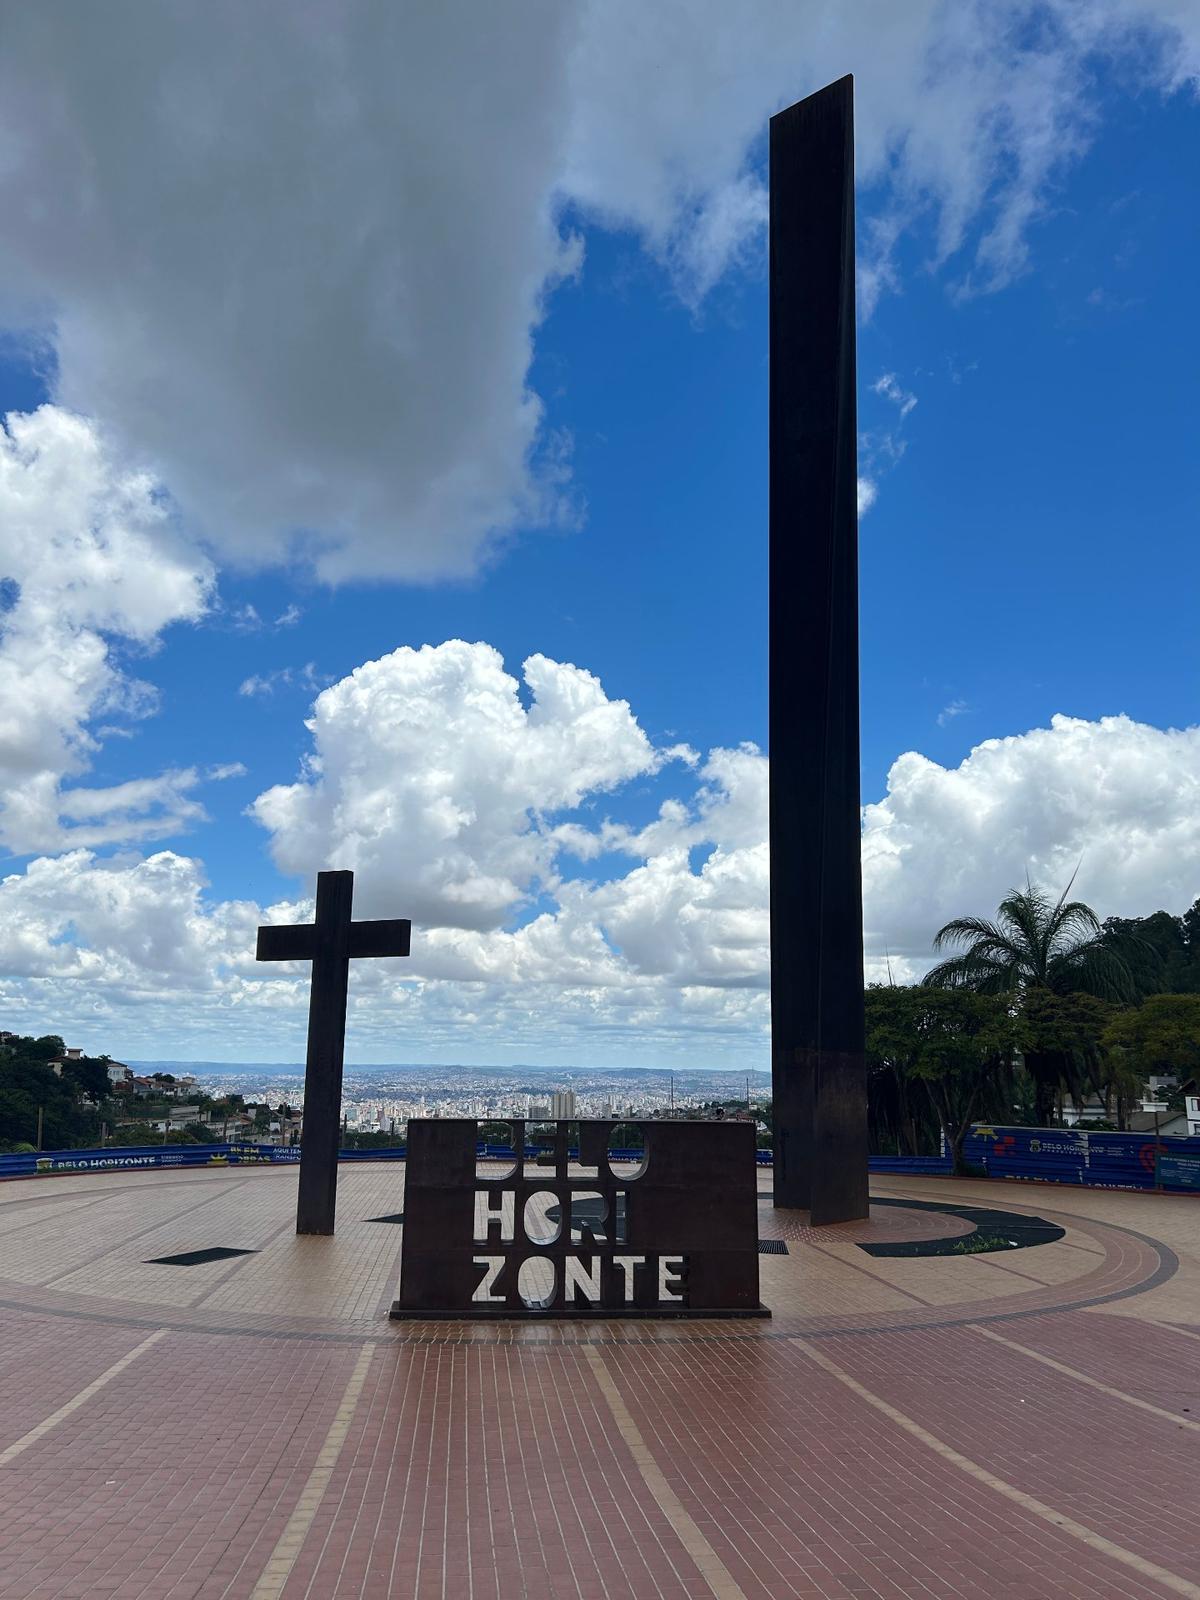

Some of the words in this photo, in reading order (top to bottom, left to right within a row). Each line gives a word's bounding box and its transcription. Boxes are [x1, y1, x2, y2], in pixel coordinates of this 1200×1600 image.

[90, 1156, 155, 1169] HORIZONTE
[475, 1121, 651, 1181] BELO
[472, 1190, 629, 1246] HORI
[471, 1255, 688, 1310] ZONTE
